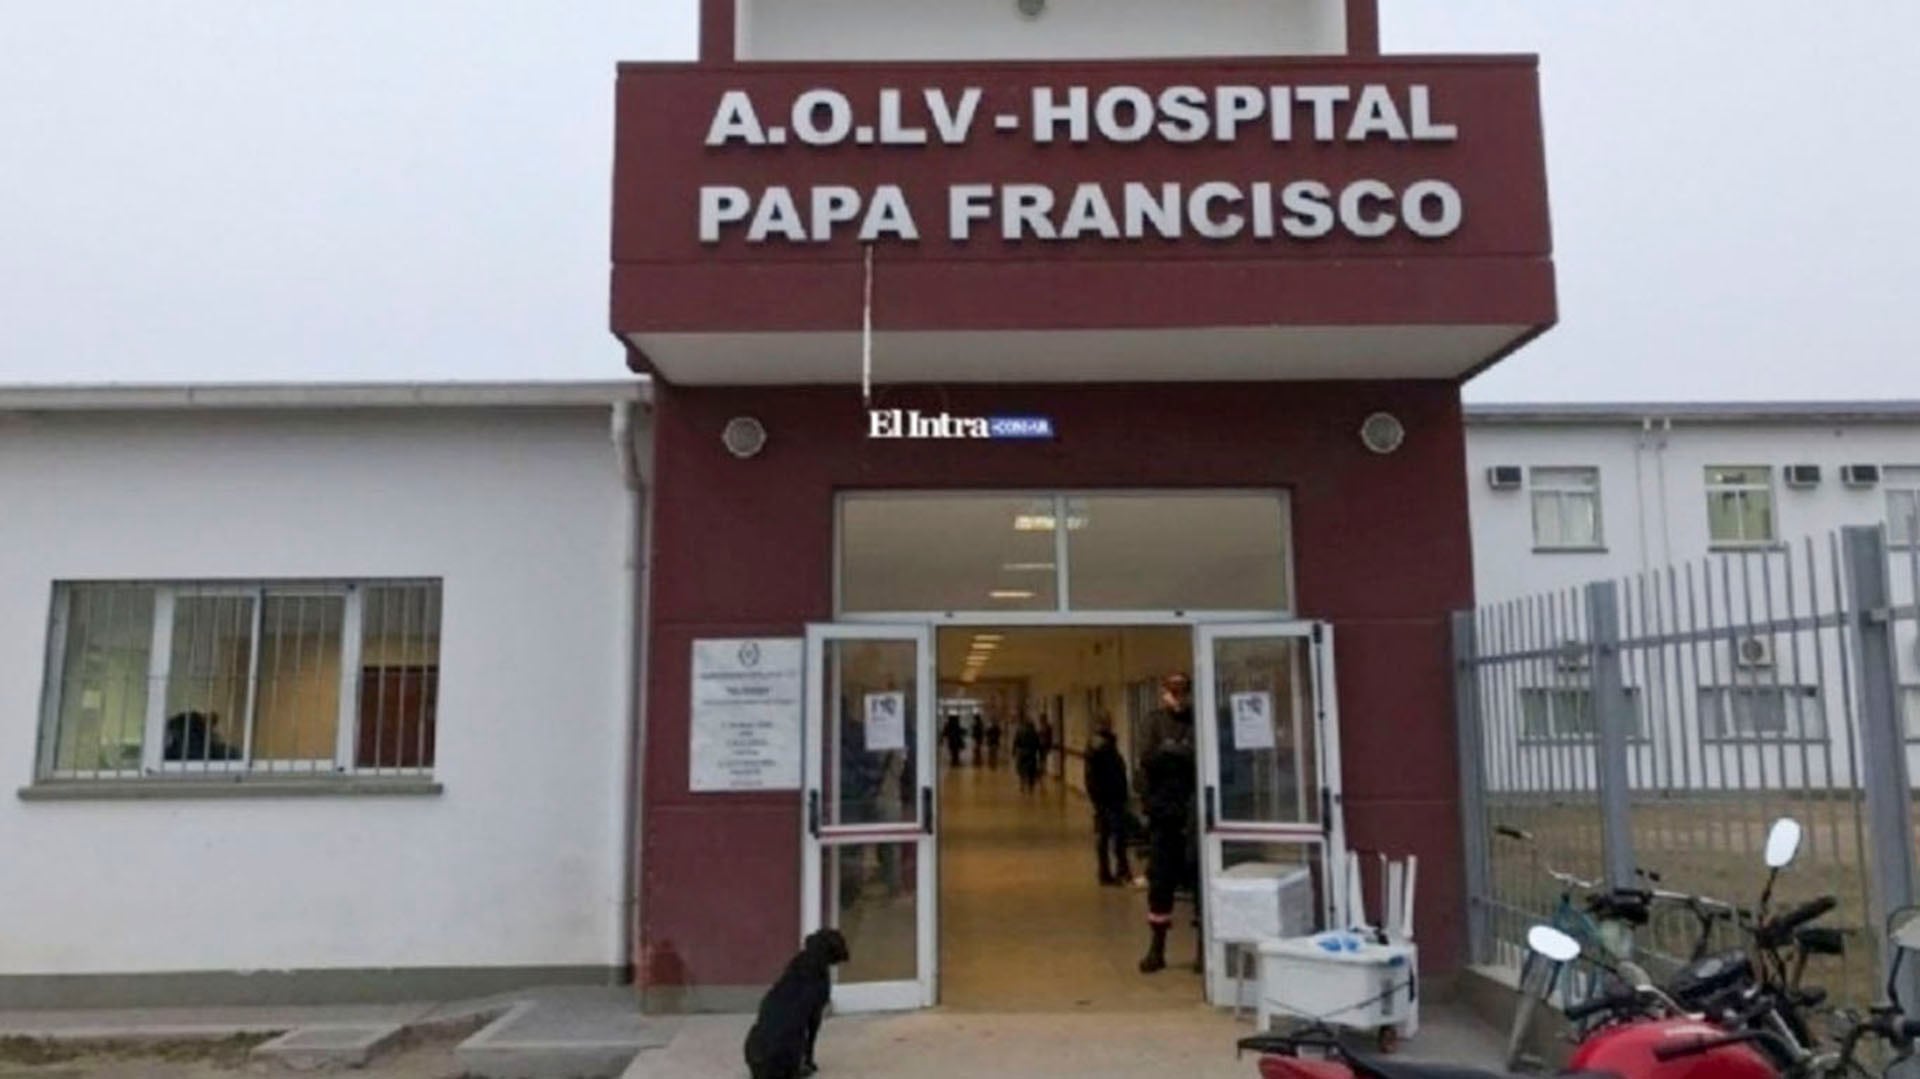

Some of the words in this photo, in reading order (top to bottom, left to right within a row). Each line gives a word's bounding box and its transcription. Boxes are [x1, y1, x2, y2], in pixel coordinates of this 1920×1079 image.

[705, 87, 982, 147] A.O.LV
[1032, 84, 1458, 143] HOSPITAL
[699, 184, 918, 243] PAPA
[949, 179, 1462, 240] FRANCISCO
